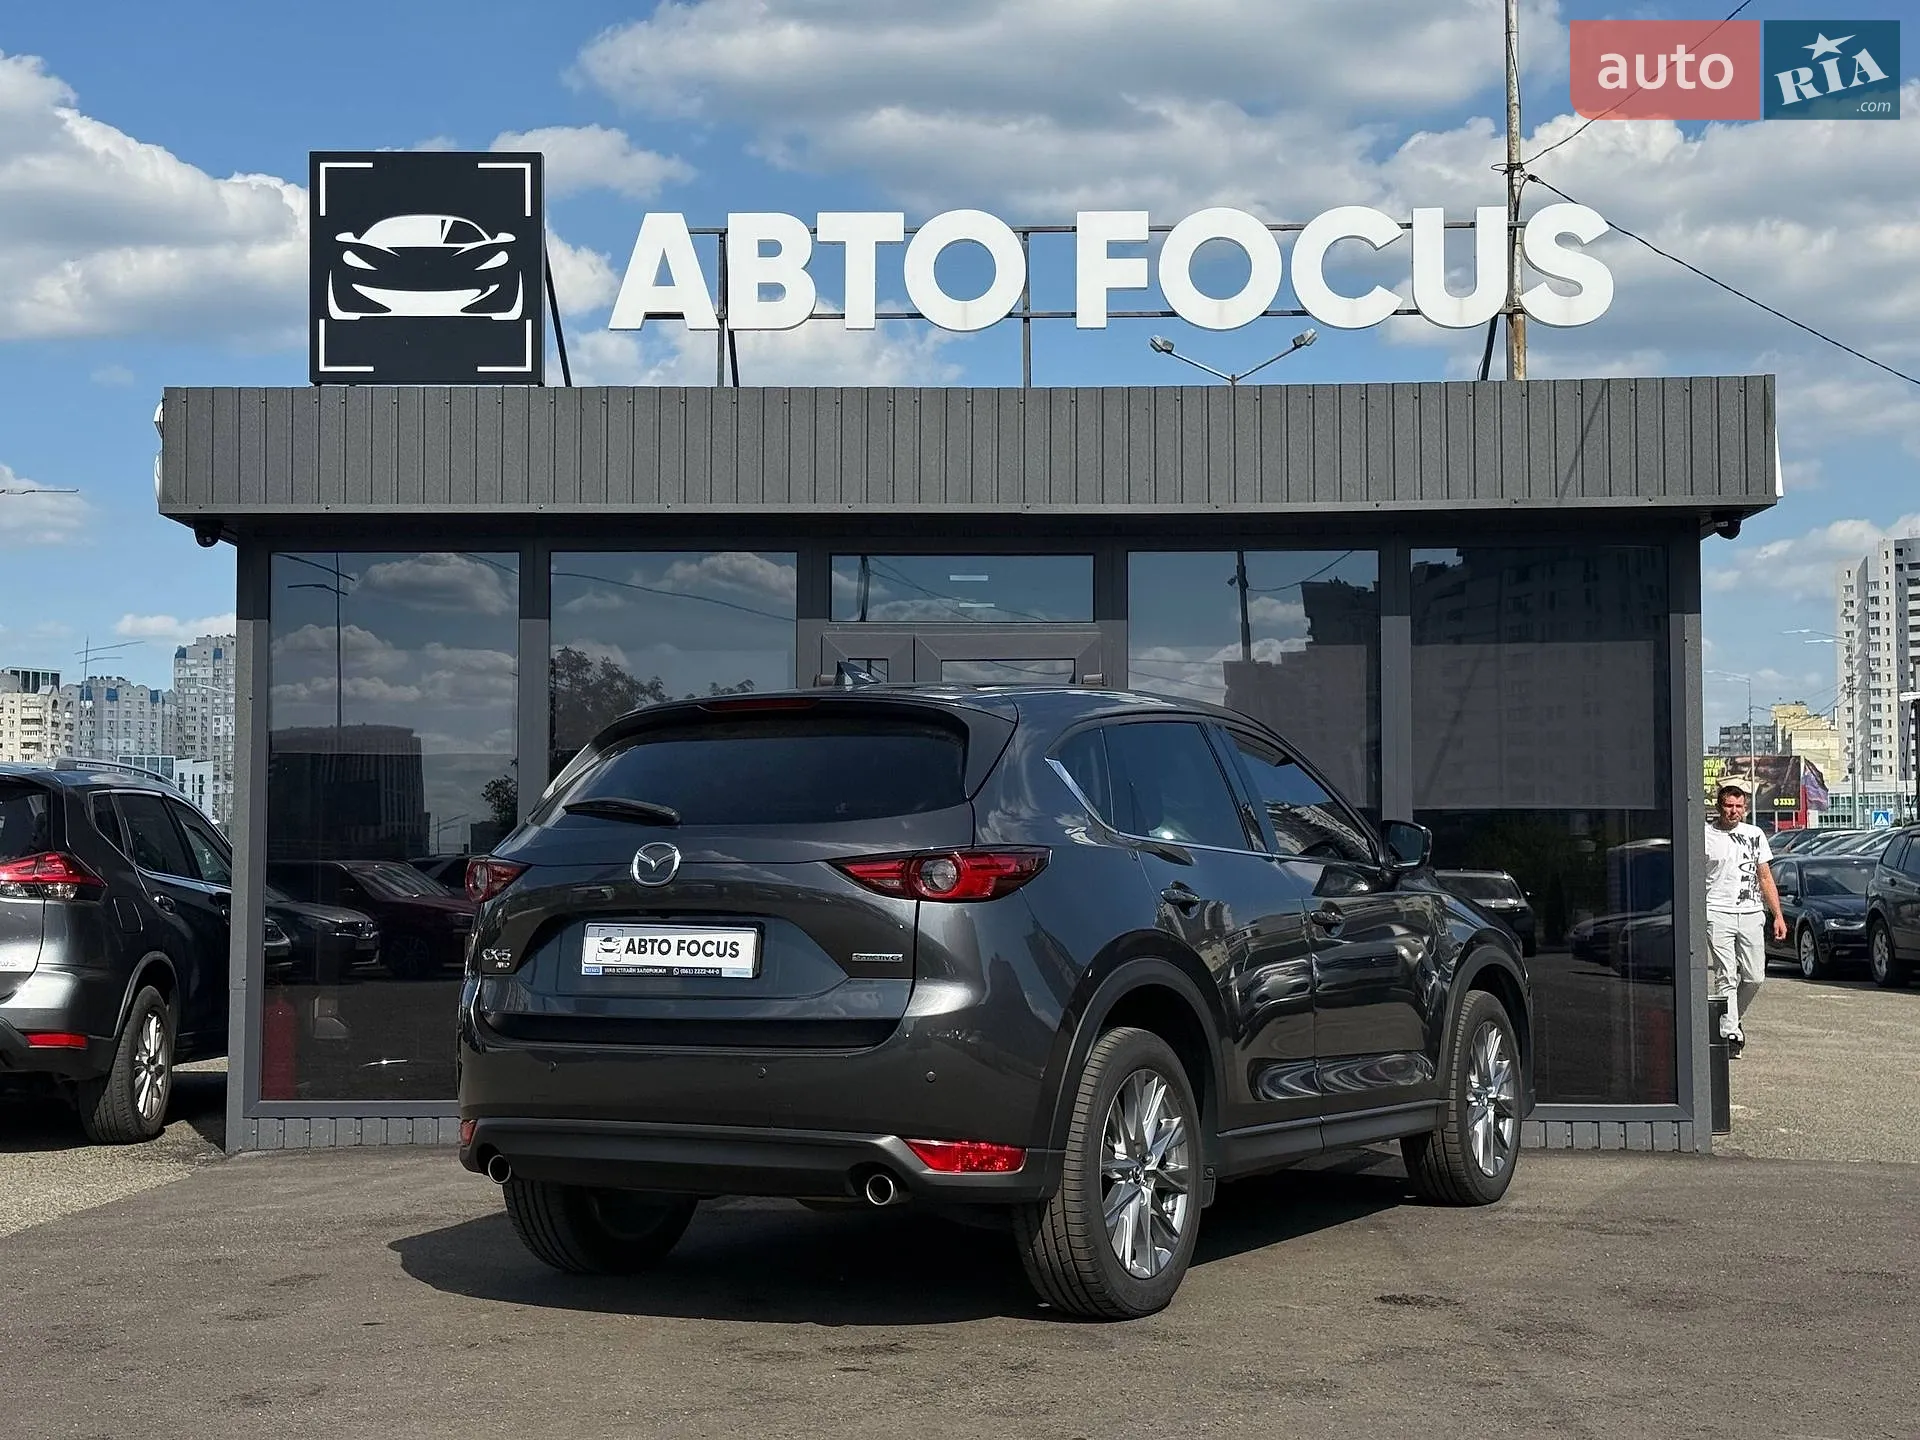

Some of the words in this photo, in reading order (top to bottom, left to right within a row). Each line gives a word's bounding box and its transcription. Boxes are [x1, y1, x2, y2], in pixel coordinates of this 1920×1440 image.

[608, 208, 1026, 331] АВТО
[1076, 203, 1615, 330] FOCUS
[625, 938, 672, 956] АВТО
[676, 939, 740, 959] FOCUS
